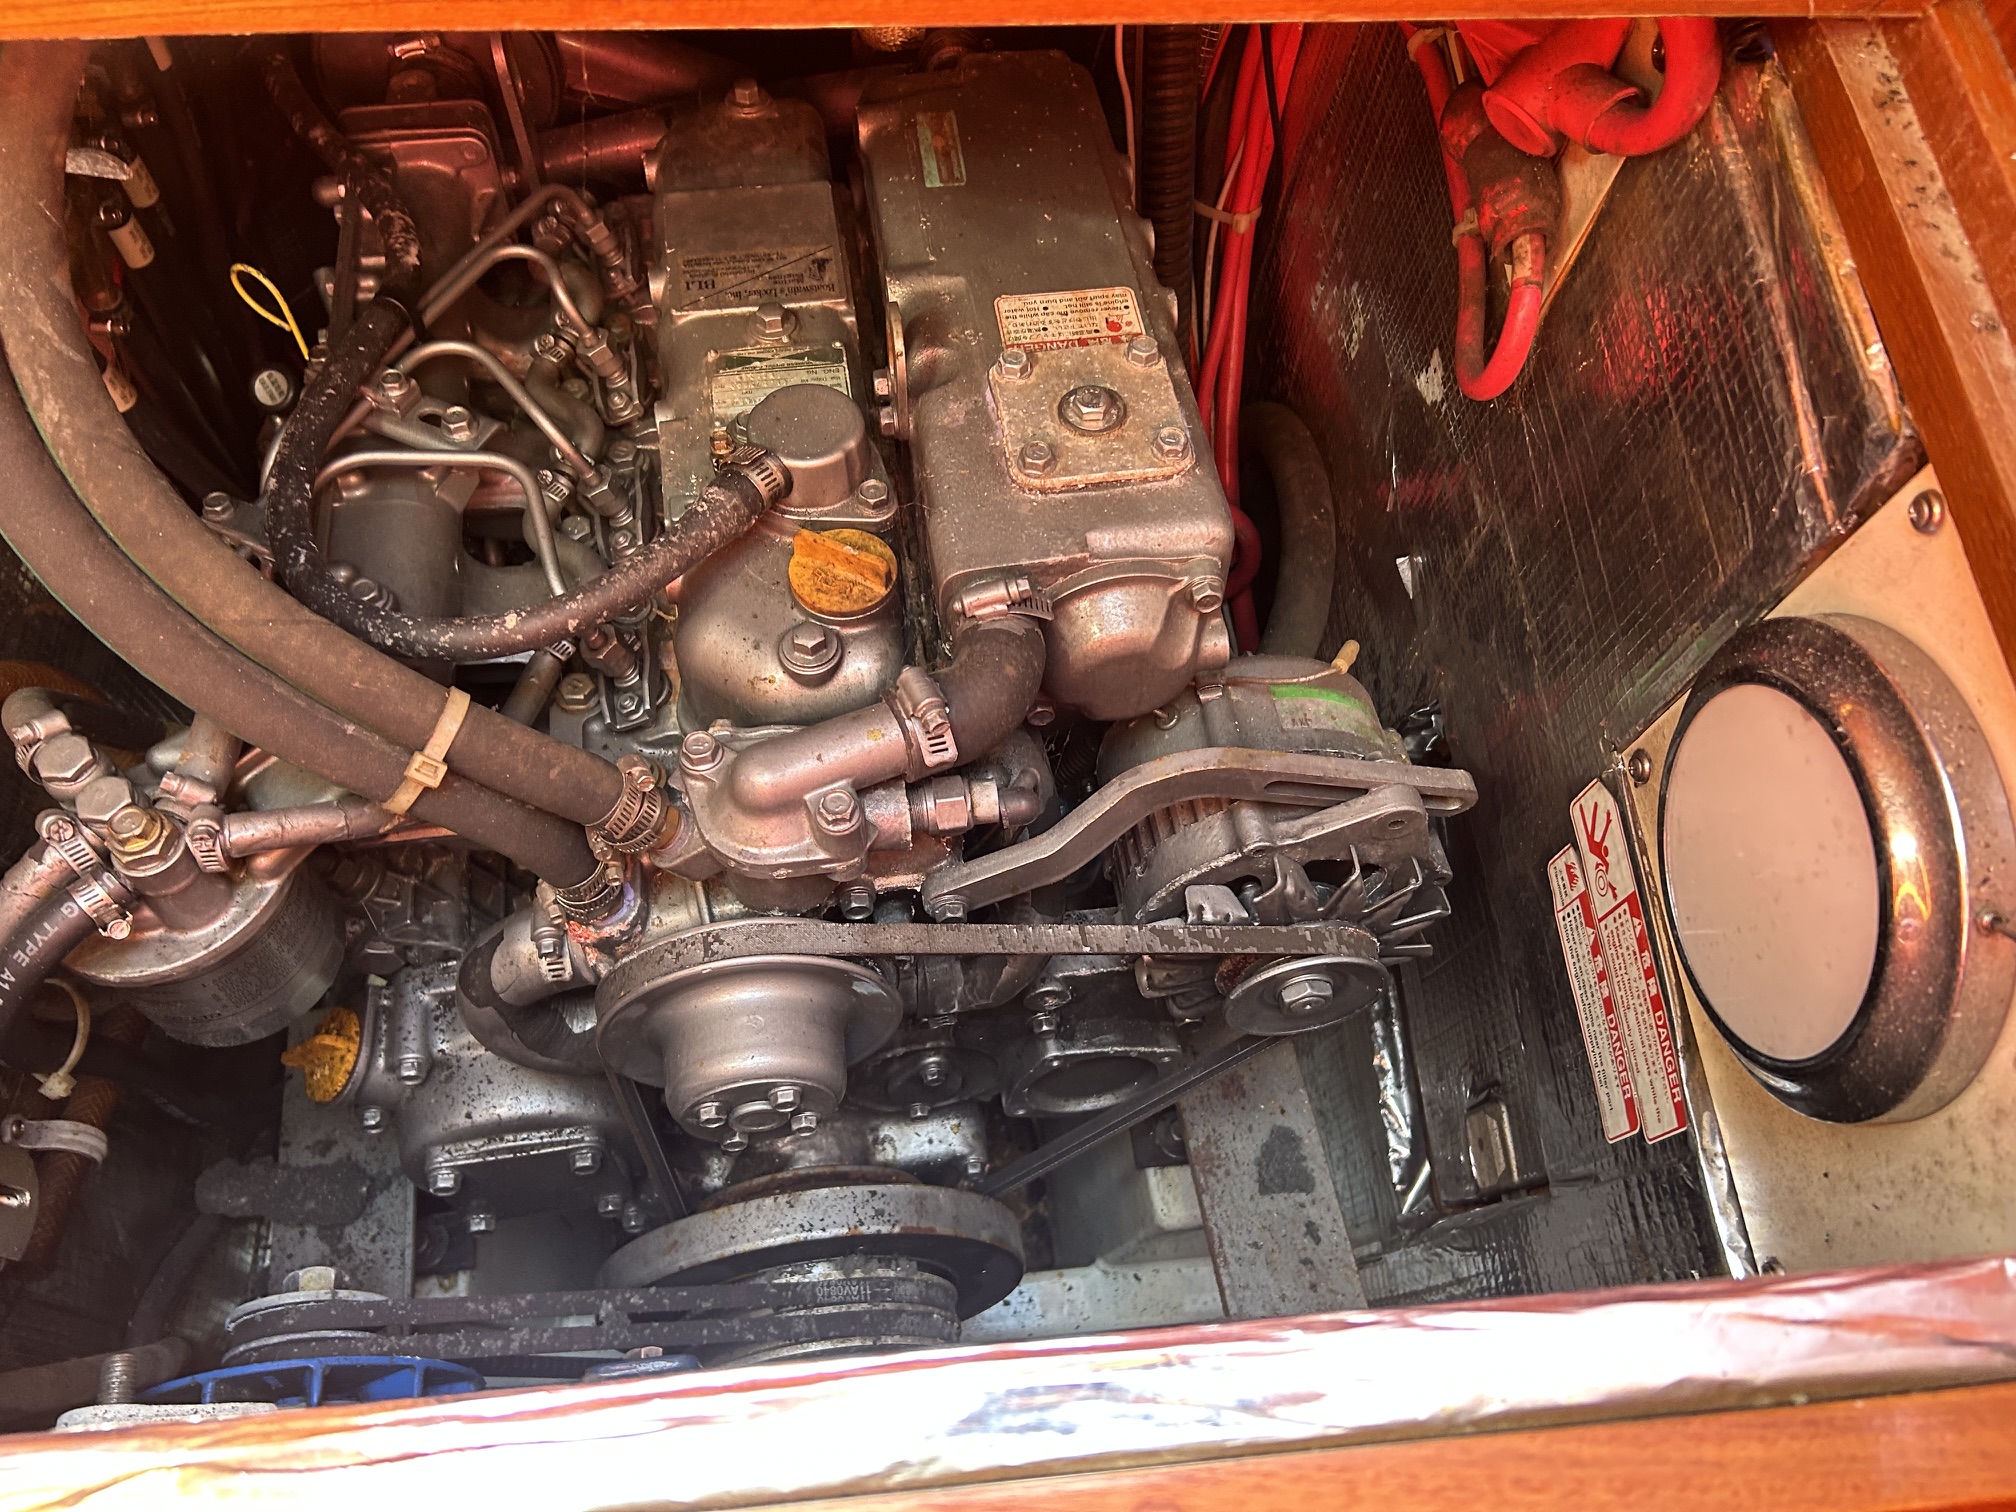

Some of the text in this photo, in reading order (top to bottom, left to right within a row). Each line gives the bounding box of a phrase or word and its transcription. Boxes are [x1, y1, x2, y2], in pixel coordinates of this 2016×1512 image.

[685, 279, 715, 290] BLI
[743, 287, 777, 298] Locker,
[779, 283, 834, 296] Boatswain's
[13, 921, 59, 967] TYPE
[1567, 919, 1576, 945] Never
[1578, 965, 1583, 977] an
[1592, 1029, 1600, 1050] near
[1610, 929, 1619, 961] engine
[1572, 961, 1582, 991] engine
[1579, 992, 1588, 1022] before
[1586, 1023, 1598, 1069] supplying
[1610, 952, 1619, 979] could
[1616, 979, 1622, 993] be
[1620, 994, 1632, 1038] seriously
[1614, 925, 1622, 951] Keep
[1620, 952, 1628, 976] away
[1626, 977, 1634, 1001] from
[1632, 1002, 1645, 1049] rotational
[1641, 1051, 1651, 1077] parts
[1649, 1078, 1657, 1105] while
[1608, 1015, 1631, 1098] DANGER
[1656, 1012, 1681, 1102] DANGER
